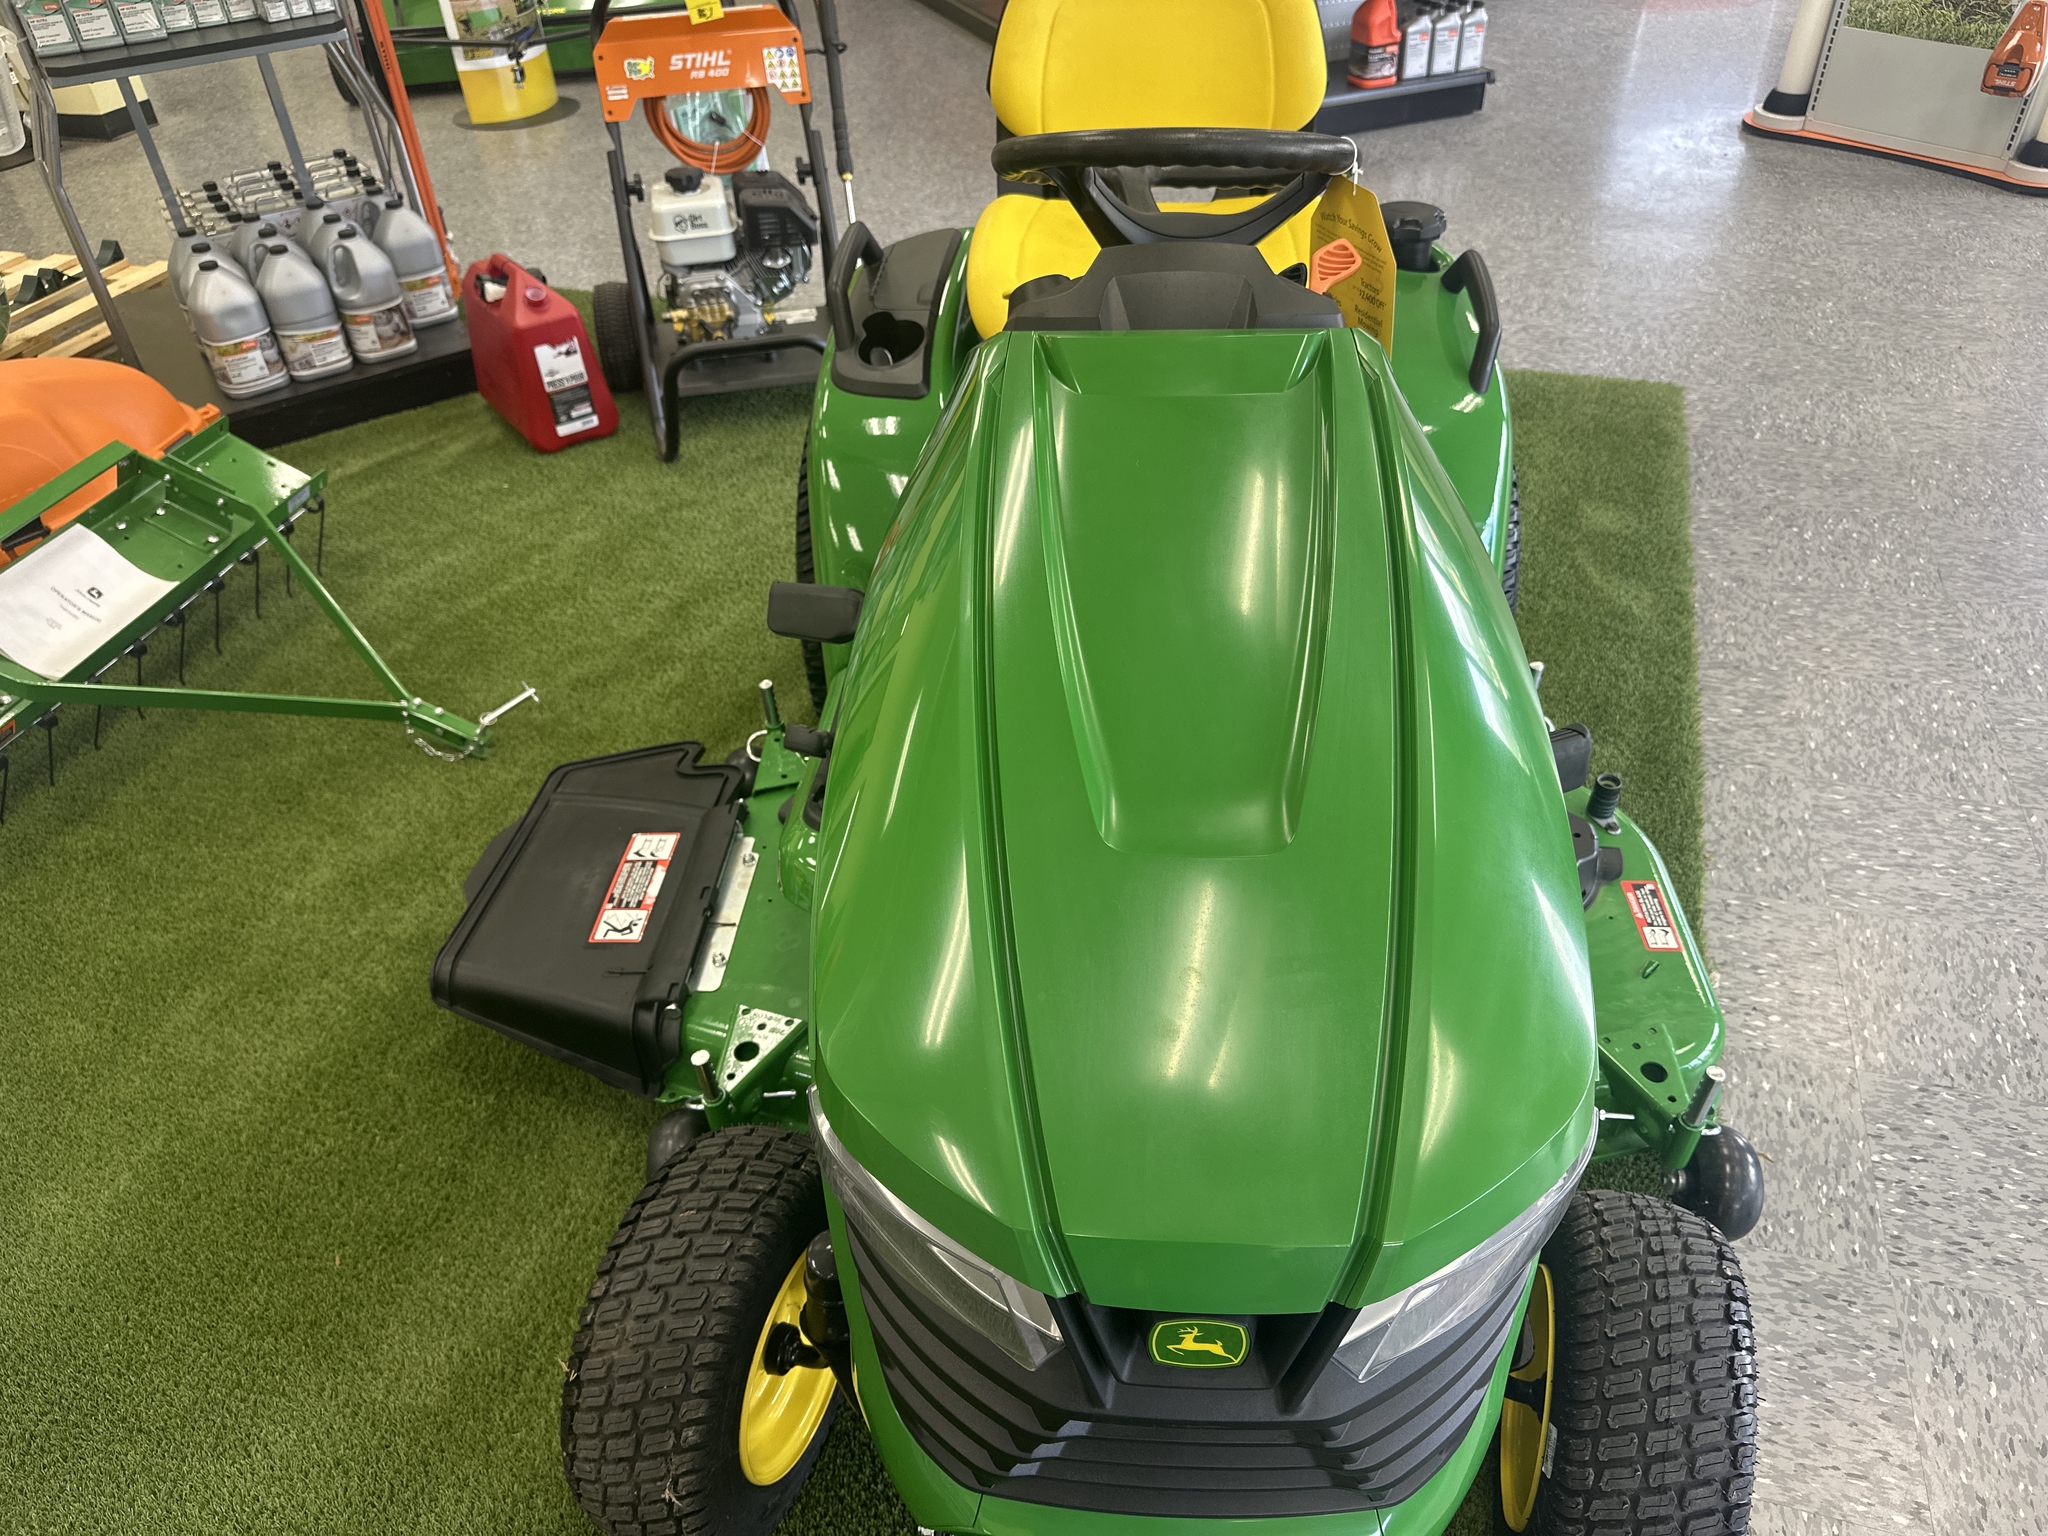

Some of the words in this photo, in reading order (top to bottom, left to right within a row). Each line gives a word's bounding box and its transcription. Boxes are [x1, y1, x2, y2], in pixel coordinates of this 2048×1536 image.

[669, 52, 731, 71] STIHL
[707, 67, 730, 78] 400
[1994, 78, 2016, 87] STIHL
[1320, 211, 1336, 222] Watch
[1336, 213, 1348, 227] Your
[1348, 218, 1367, 240] Savings
[1367, 233, 1382, 253] Grow
[1360, 278, 1380, 296] Tractors
[1354, 304, 1383, 328] Residential
[1357, 316, 1379, 338] Mowing
